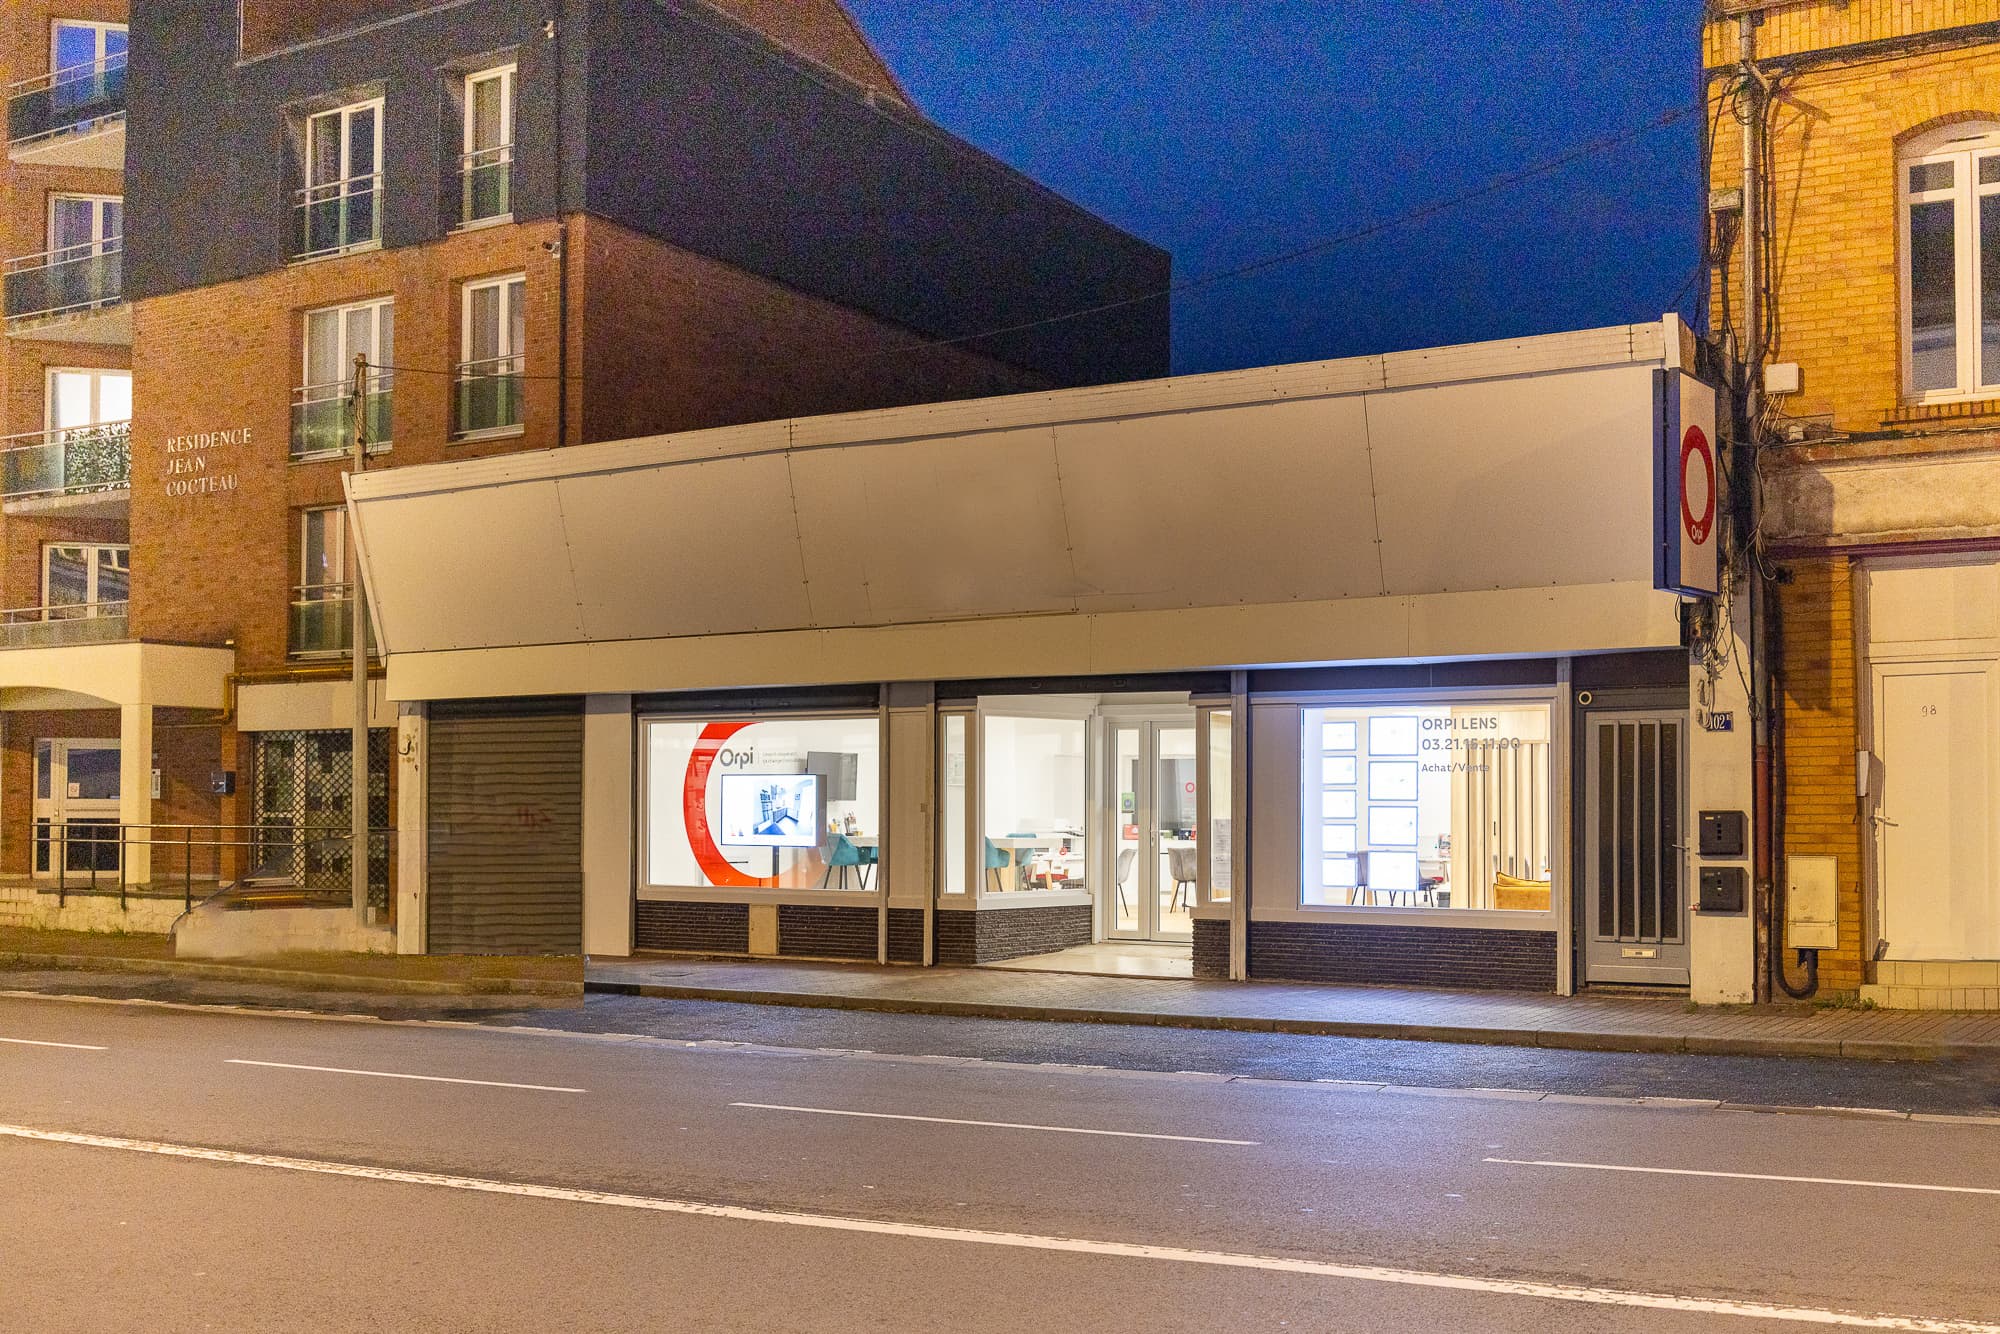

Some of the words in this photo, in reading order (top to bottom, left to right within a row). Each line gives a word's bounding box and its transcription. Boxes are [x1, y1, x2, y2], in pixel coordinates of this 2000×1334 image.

[166, 427, 252, 453] RESIDENCE
[166, 456, 206, 474] JEAN
[166, 473, 238, 497] COCTEAU
[1691, 524, 1703, 543] Orpi
[1422, 718, 1457, 730] ORPI
[1461, 717, 1498, 730] LENS
[720, 746, 753, 769] Orpi
[1421, 762, 1490, 773] Achat/Vente
